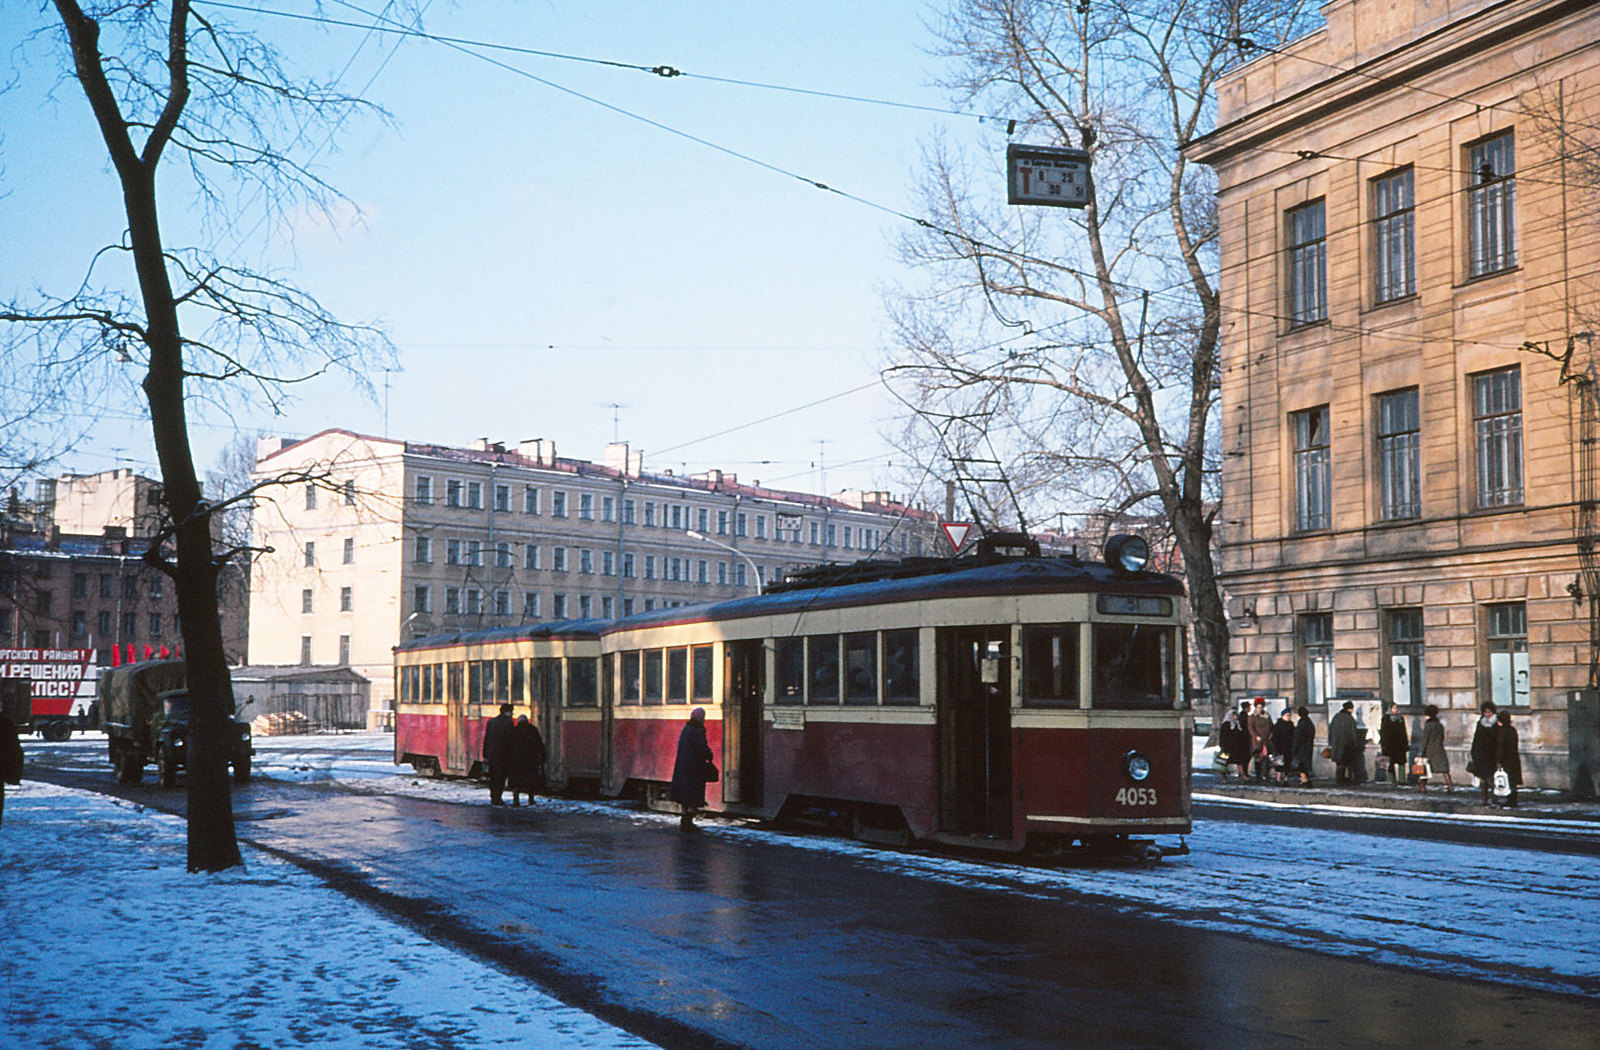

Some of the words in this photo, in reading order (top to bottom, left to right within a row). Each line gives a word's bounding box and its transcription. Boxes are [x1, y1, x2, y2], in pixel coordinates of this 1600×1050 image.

[0, 649, 39, 660] РГСКОГО
[10, 664, 82, 680] РЕШЕНИЯ
[1115, 787, 1158, 806] 4053
